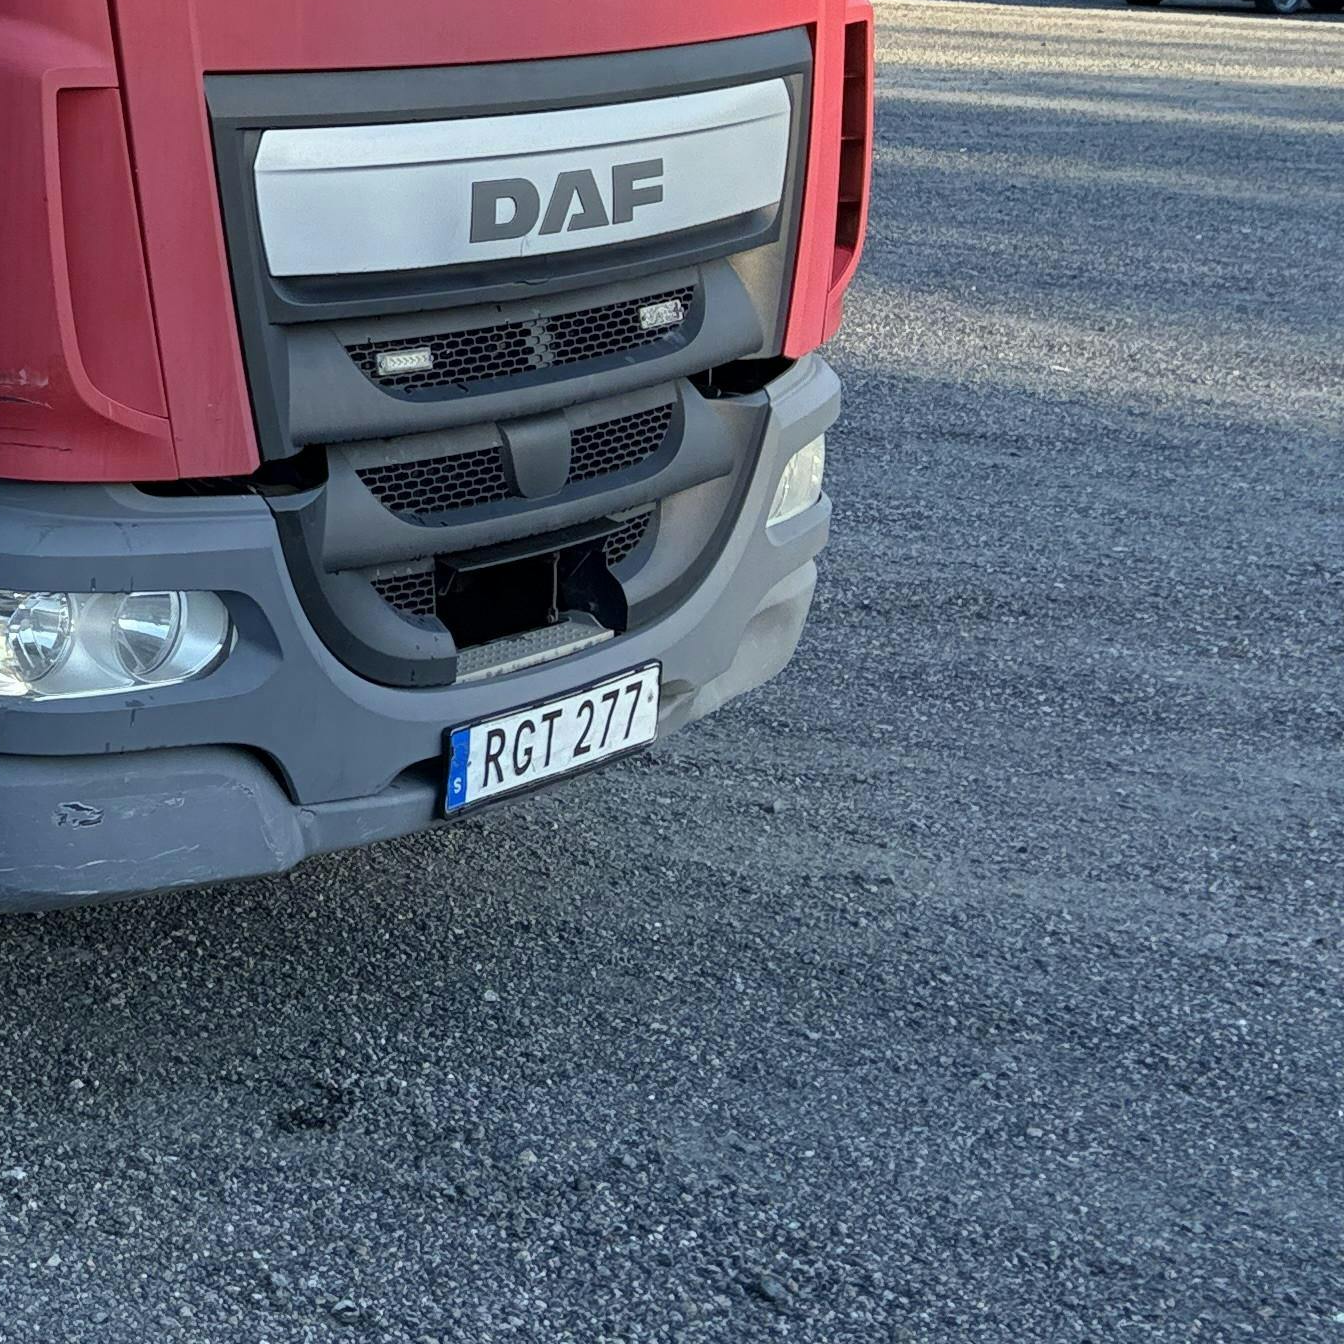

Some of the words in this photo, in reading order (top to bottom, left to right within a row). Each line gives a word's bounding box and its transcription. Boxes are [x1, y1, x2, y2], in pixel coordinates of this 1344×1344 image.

[470, 158, 664, 244] DAF
[482, 708, 563, 788] RGT
[573, 680, 643, 758] 277
[452, 776, 462, 794] S
